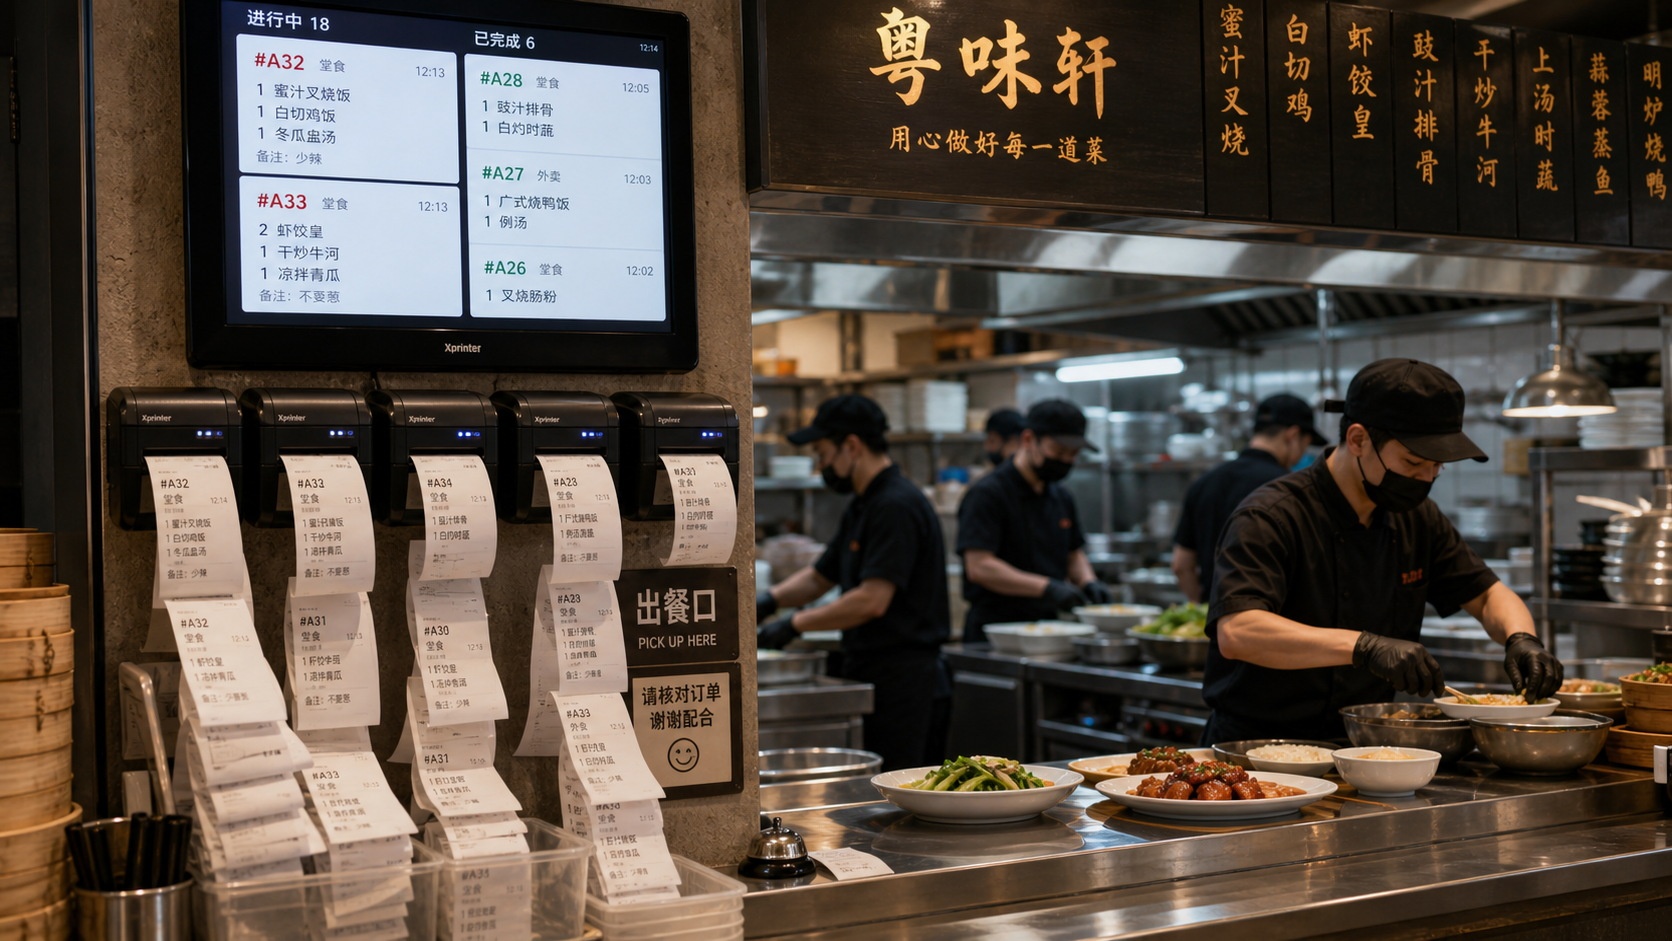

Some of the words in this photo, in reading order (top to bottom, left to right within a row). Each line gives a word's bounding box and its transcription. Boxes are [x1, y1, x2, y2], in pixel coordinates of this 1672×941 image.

[247, 9, 302, 30] 进行中
[311, 17, 329, 31] 18
[474, 31, 520, 49] 已完成
[526, 37, 535, 49] 6
[640, 44, 658, 52] 12:14
[255, 53, 304, 70] #A32
[320, 59, 345, 72] 堂食
[869, 7, 1117, 119] 粤味轩
[1284, 14, 1312, 123] 白切鸡
[416, 66, 445, 78] 12:13
[480, 72, 522, 87] #A28
[536, 76, 559, 89] 堂食
[1220, 4, 1249, 156] 蜜汁叉烧
[1348, 22, 1377, 140] 虾饺皇
[257, 84, 263, 96] 1
[274, 84, 350, 102] 蜜汁叉烧饭
[623, 83, 649, 93] 12:05
[257, 106, 263, 118] 1
[275, 106, 336, 123] 白切鸡饭
[483, 100, 488, 111] 1
[497, 101, 553, 117] 豉汁排骨
[1412, 30, 1439, 185] 豉汁排骨
[1474, 39, 1498, 187] 干炒牛河
[1533, 47, 1558, 191] 上汤时蔬
[1589, 52, 1613, 194] 蒜蓉蒸鱼
[258, 127, 264, 139] 1
[483, 121, 488, 132] 1
[1643, 61, 1667, 200] 明炉烧鸭
[890, 125, 1107, 165] 用心做好每一道菜
[482, 166, 524, 181] #A27
[537, 170, 560, 183] 外卖
[624, 174, 651, 184] 12:03
[257, 194, 307, 209] #A33
[322, 198, 348, 210] 堂食
[419, 202, 448, 212] 12:13
[485, 195, 489, 206] 1
[499, 195, 569, 211] 广式烧鸭饭
[485, 216, 490, 227] 1
[500, 216, 527, 229] 例汤
[259, 224, 267, 236] 2
[277, 224, 323, 238] 虾饺皇
[260, 246, 266, 257] 1
[278, 246, 339, 261] 干炒牛河
[261, 268, 266, 279] 1
[278, 268, 340, 282] 凉拌青瓜
[484, 261, 526, 275] #A26
[539, 263, 562, 276] 堂食
[627, 266, 653, 276] 12:02
[486, 290, 491, 301] 1
[502, 289, 557, 303] 叉烧肠粉
[445, 343, 481, 354] Xprinter
[142, 414, 172, 422] Xprinter
[161, 479, 189, 489] #A32
[298, 479, 324, 488] #A33
[428, 478, 452, 488] #A34
[637, 588, 716, 626] 出餐口
[181, 618, 209, 628] #A32
[300, 616, 326, 626] #A31
[424, 625, 449, 636] #A30
[638, 636, 665, 649] PICK
[669, 635, 683, 647] UP
[688, 634, 716, 646] HERE
[642, 682, 721, 706] 请核对订单
[567, 708, 591, 718] #A33
[650, 708, 714, 730] 谢谢配合
[425, 754, 448, 764] #A31
